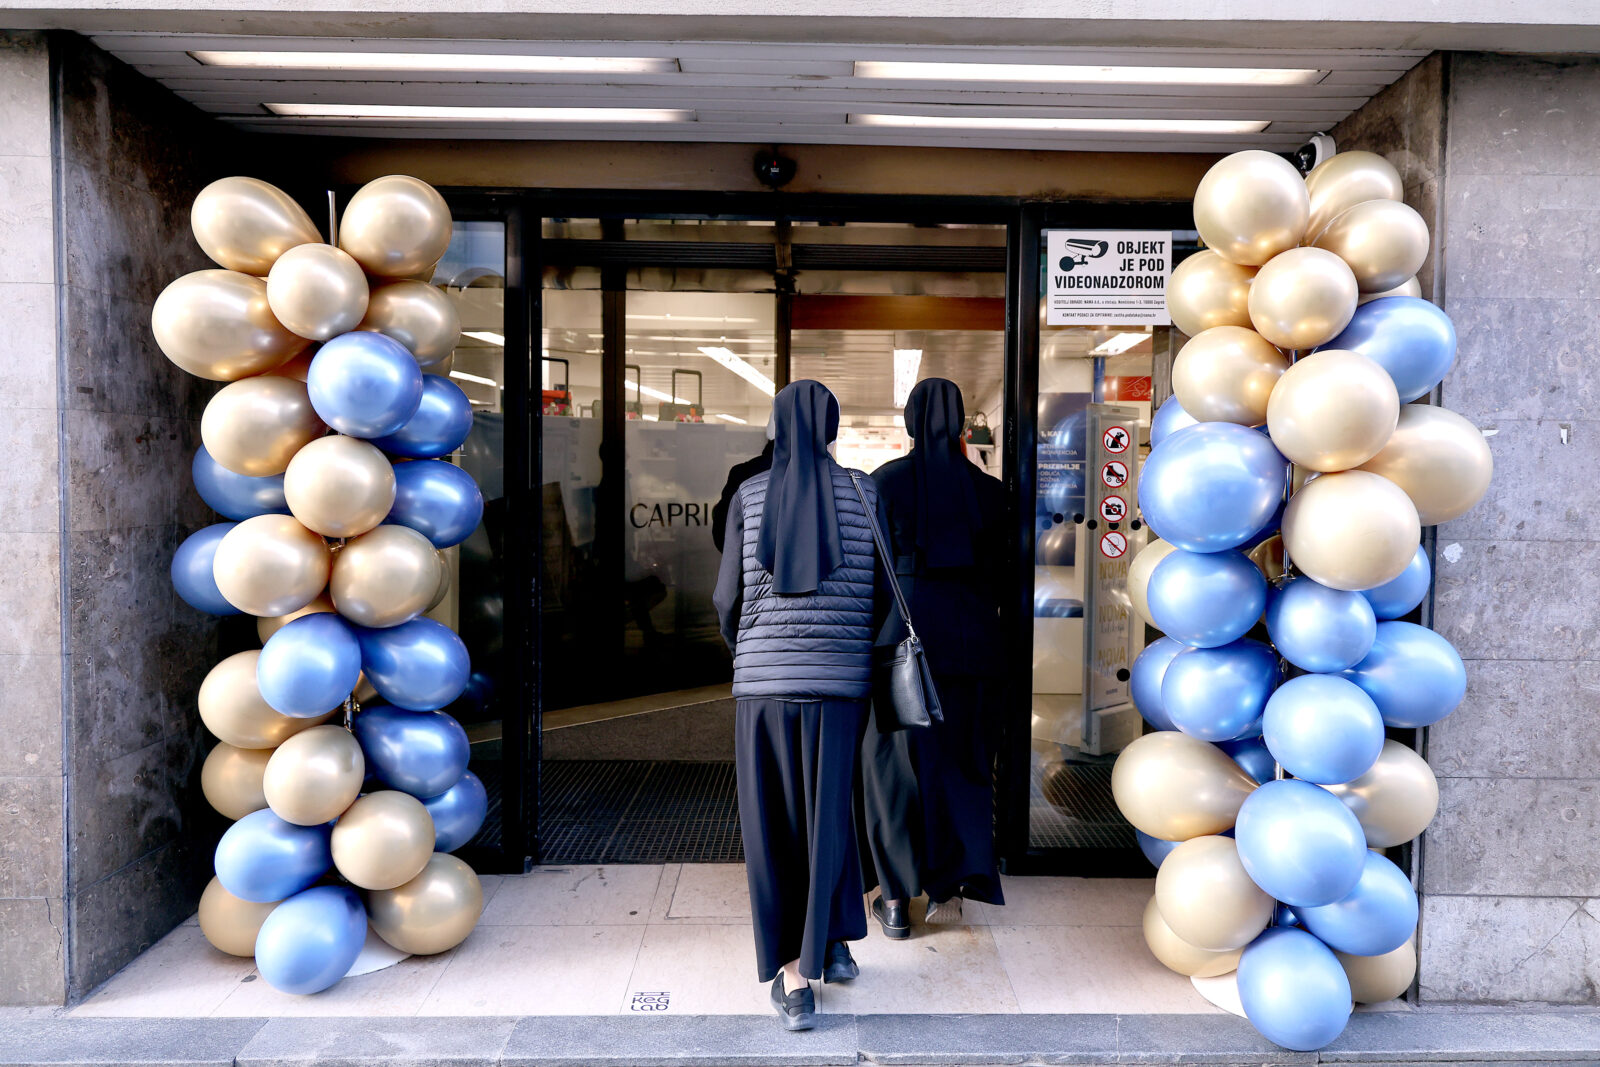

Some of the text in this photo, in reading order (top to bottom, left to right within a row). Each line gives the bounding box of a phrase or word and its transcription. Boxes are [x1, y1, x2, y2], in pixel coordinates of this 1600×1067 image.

[1117, 241, 1165, 254] OBJEKT
[1119, 258, 1164, 271] JE POD
[1054, 275, 1164, 289] VIDEONADZOROM
[629, 502, 714, 528] CAPRI
